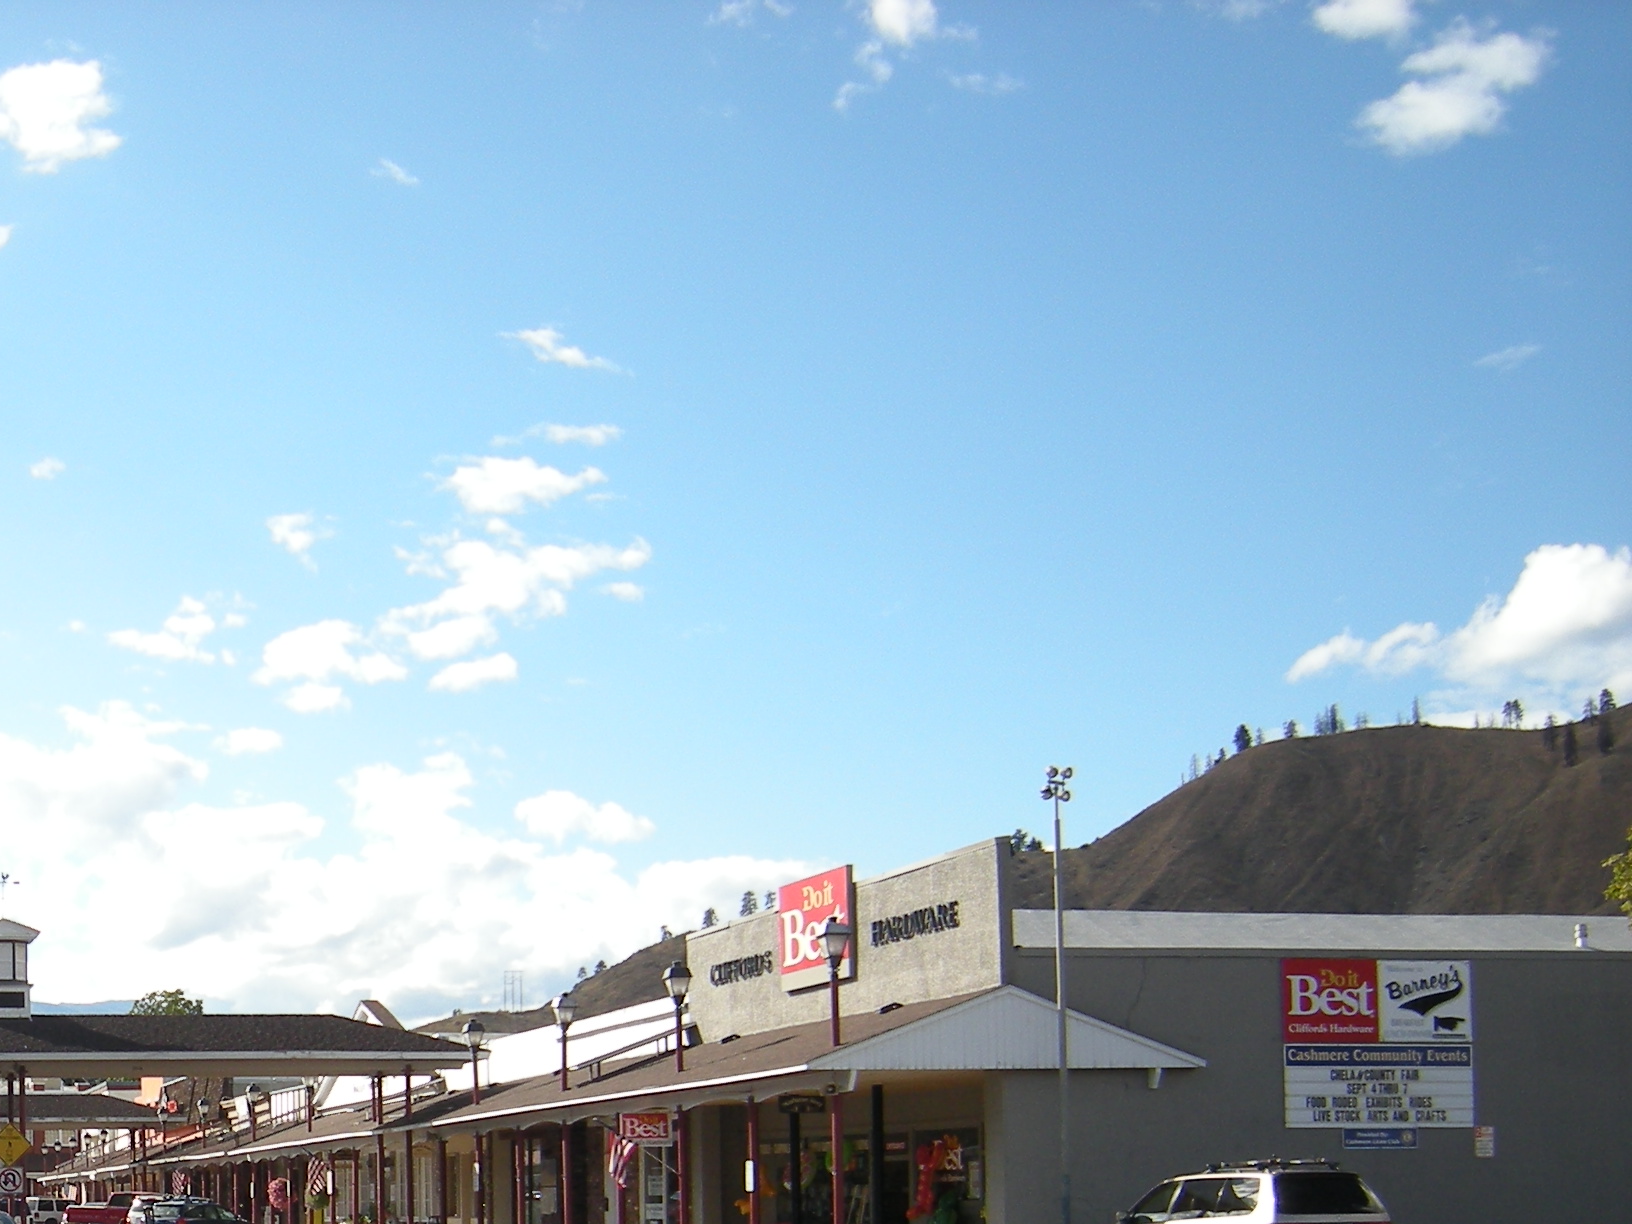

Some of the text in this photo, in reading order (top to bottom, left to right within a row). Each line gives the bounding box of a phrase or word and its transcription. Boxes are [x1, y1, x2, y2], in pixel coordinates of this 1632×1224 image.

[802, 880, 834, 911] Do it
[870, 900, 960, 948] HARDWARE
[710, 950, 772, 987] CLIFFORDS
[1320, 969, 1359, 987] Do it
[1385, 964, 1459, 1000] Barney's
[1286, 974, 1374, 1017] Best
[1288, 1023, 1328, 1034] Cliffords
[1329, 1023, 1374, 1034] Hardware
[1287, 1049, 1468, 1064] Cashmere Community Events
[1365, 1069, 1396, 1081] COUNTY
[1401, 1069, 1419, 1081] FAIR
[1346, 1083, 1408, 1095] SEPT 4 THRU 7
[1306, 1096, 1432, 1108] FOOD RODEO EXHIBITS RIDES
[1313, 1110, 1446, 1122] LIVE STOCK ARTS AND CRAFTS
[622, 1117, 667, 1138] Best
